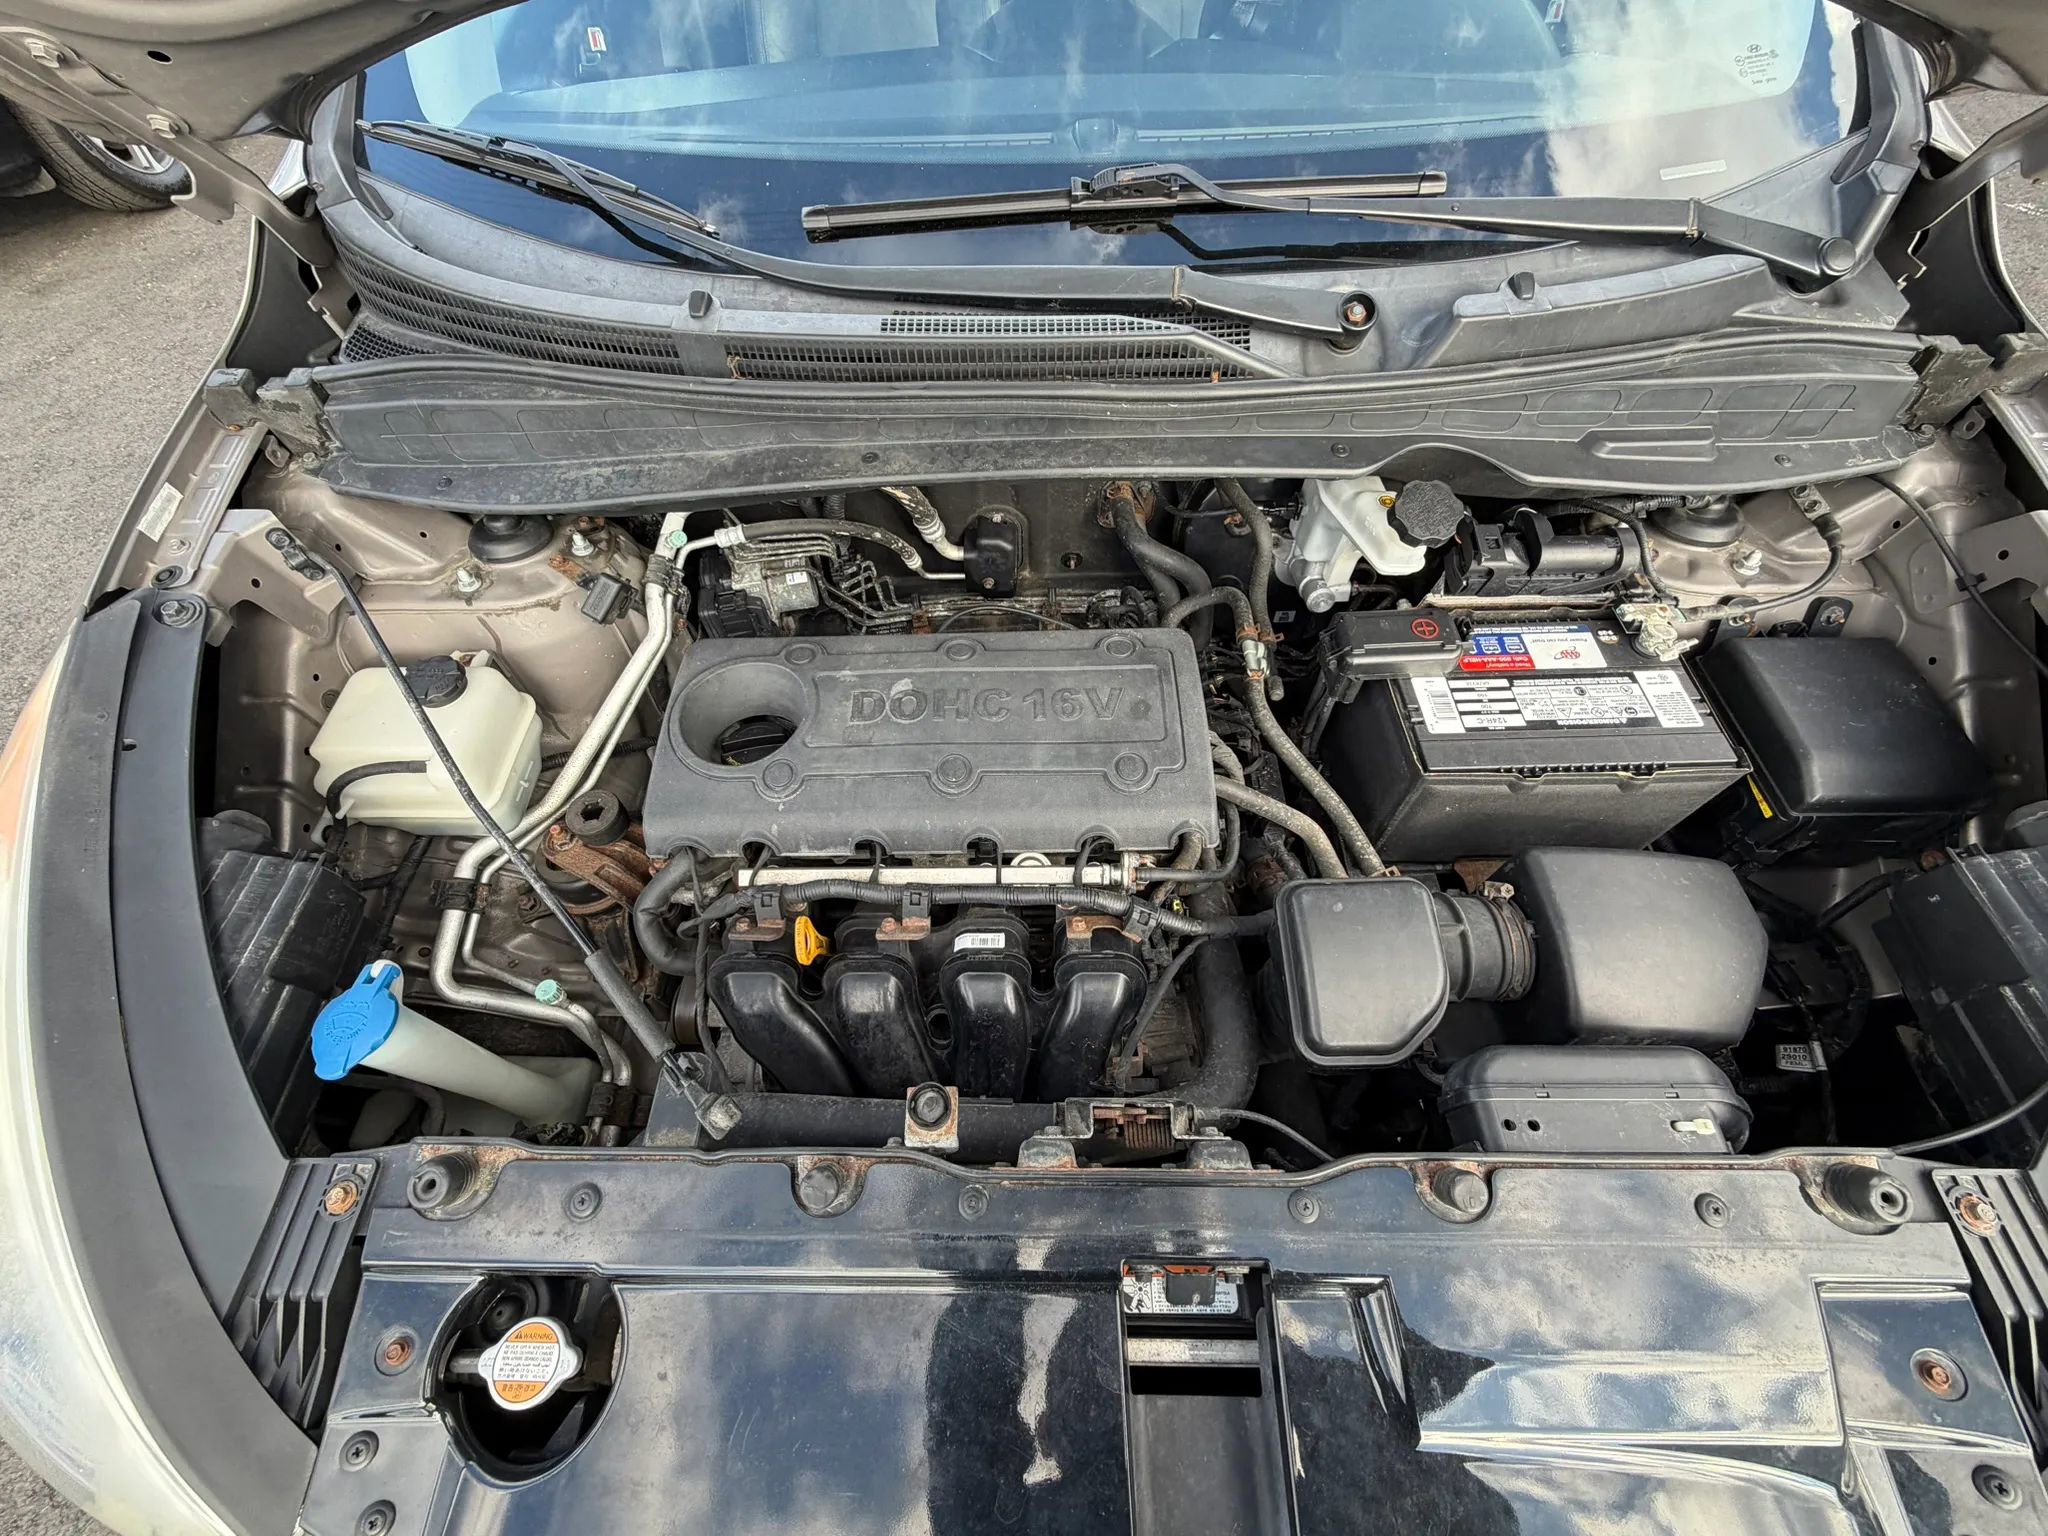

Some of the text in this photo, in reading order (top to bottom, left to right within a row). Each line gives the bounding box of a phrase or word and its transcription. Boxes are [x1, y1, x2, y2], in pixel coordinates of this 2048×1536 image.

[1560, 650, 1581, 660] AAA
[849, 686, 1125, 725] DOHC 16V
[1476, 717, 1508, 725] 124R-C
[523, 1332, 554, 1341] WARNING
